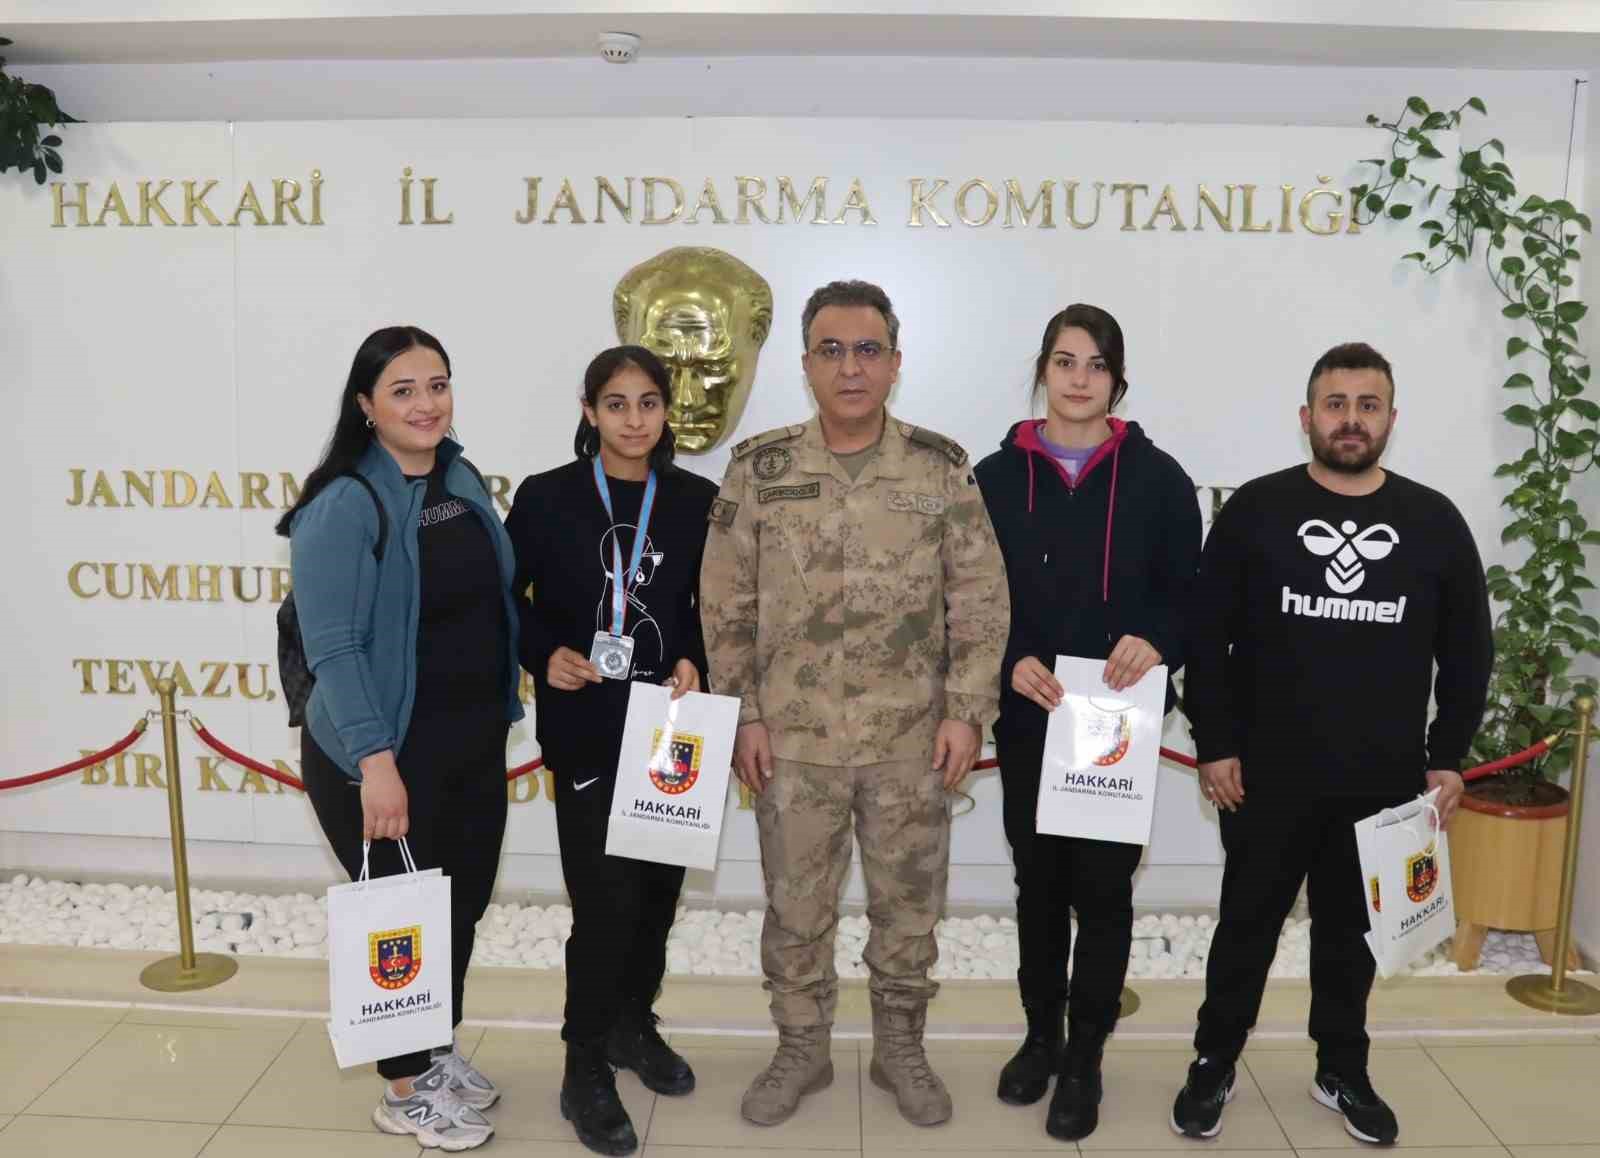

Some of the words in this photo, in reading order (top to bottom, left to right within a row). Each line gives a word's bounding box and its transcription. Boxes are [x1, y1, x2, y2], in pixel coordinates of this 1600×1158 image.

[51, 168, 325, 227] HAKKARİ
[398, 166, 454, 226] İL
[515, 175, 880, 226] JANDARMA
[1281, 586, 1407, 623] hummel
[1065, 772, 1133, 792] HAKKARİ
[634, 799, 701, 821] HAKKARİ
[361, 988, 431, 1017] HAKKARİ
